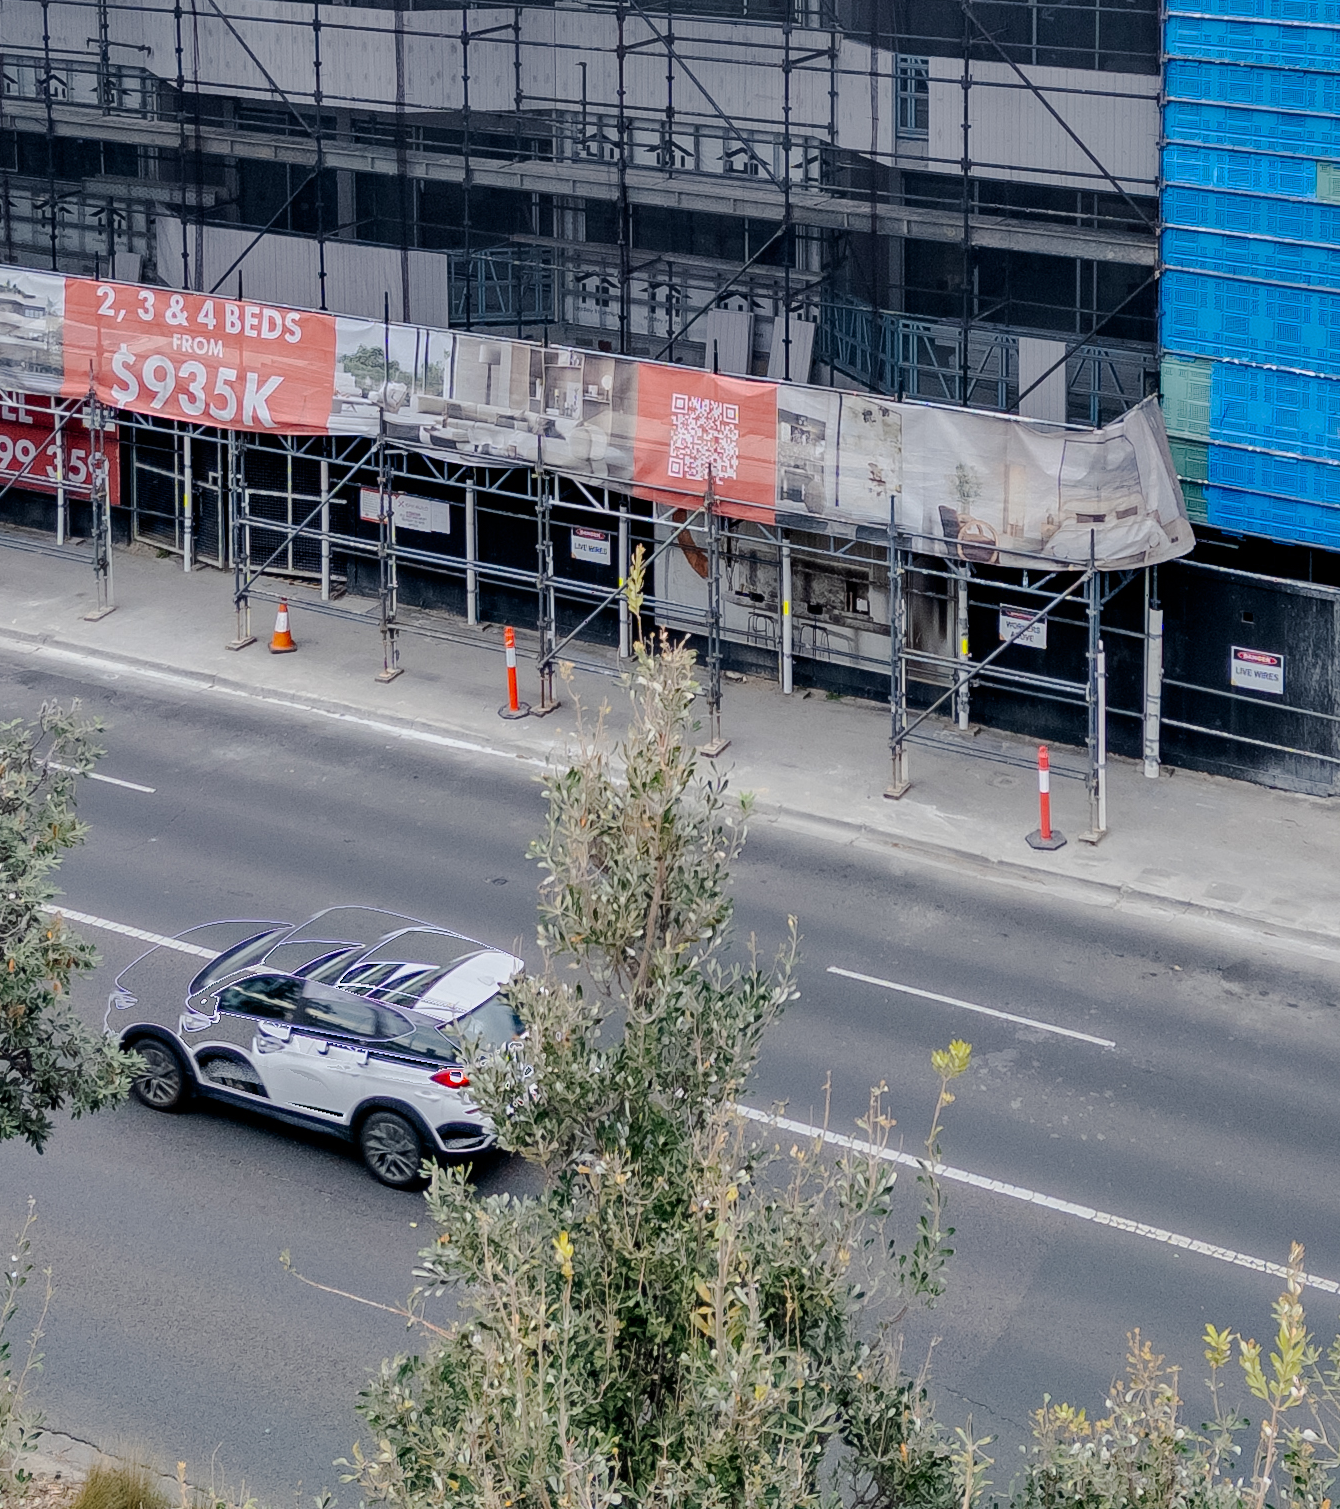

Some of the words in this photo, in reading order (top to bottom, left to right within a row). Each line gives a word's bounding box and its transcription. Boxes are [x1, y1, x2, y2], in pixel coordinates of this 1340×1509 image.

[95, 285, 127, 323] 2,
[137, 290, 156, 321] 3
[165, 294, 189, 326] &
[197, 299, 217, 330] 4
[224, 302, 302, 344] BEDS
[172, 333, 224, 358] FROM
[110, 343, 286, 429] $935K
[1236, 666, 1252, 677] LIVE
[1254, 670, 1279, 681] WIRES
